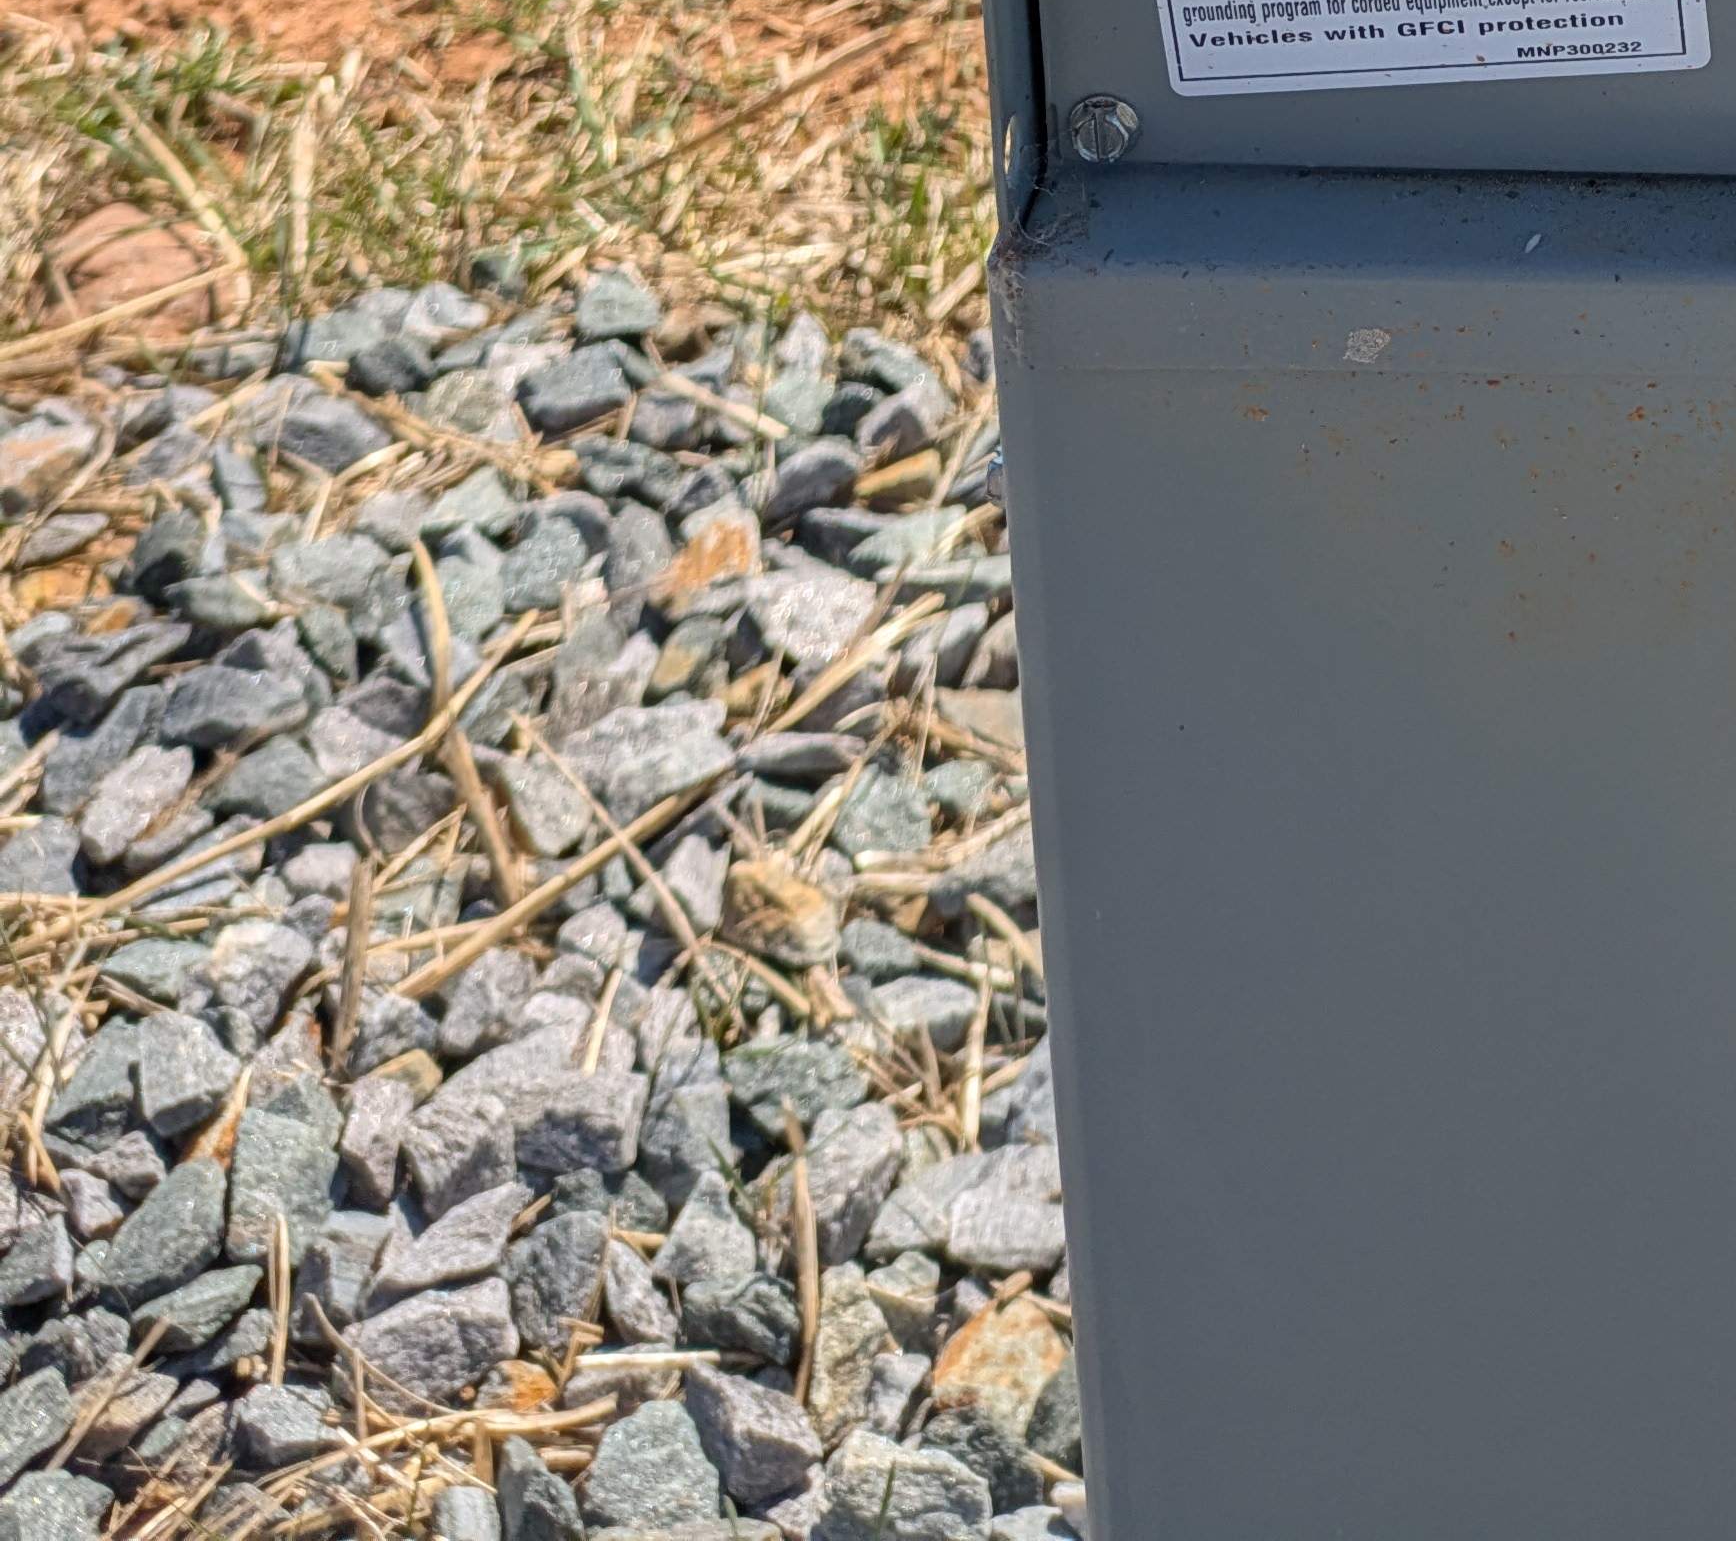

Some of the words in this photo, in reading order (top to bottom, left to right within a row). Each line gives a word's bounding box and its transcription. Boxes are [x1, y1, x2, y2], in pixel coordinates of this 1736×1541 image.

[1183, 0, 1257, 27] grounding
[1262, 0, 1322, 24] program
[1189, 30, 1312, 47] Vehicles
[1324, 25, 1384, 40] with
[1398, 20, 1464, 36] GFCI
[1479, 13, 1623, 35] protection
[1517, 42, 1642, 58] MNP300232
